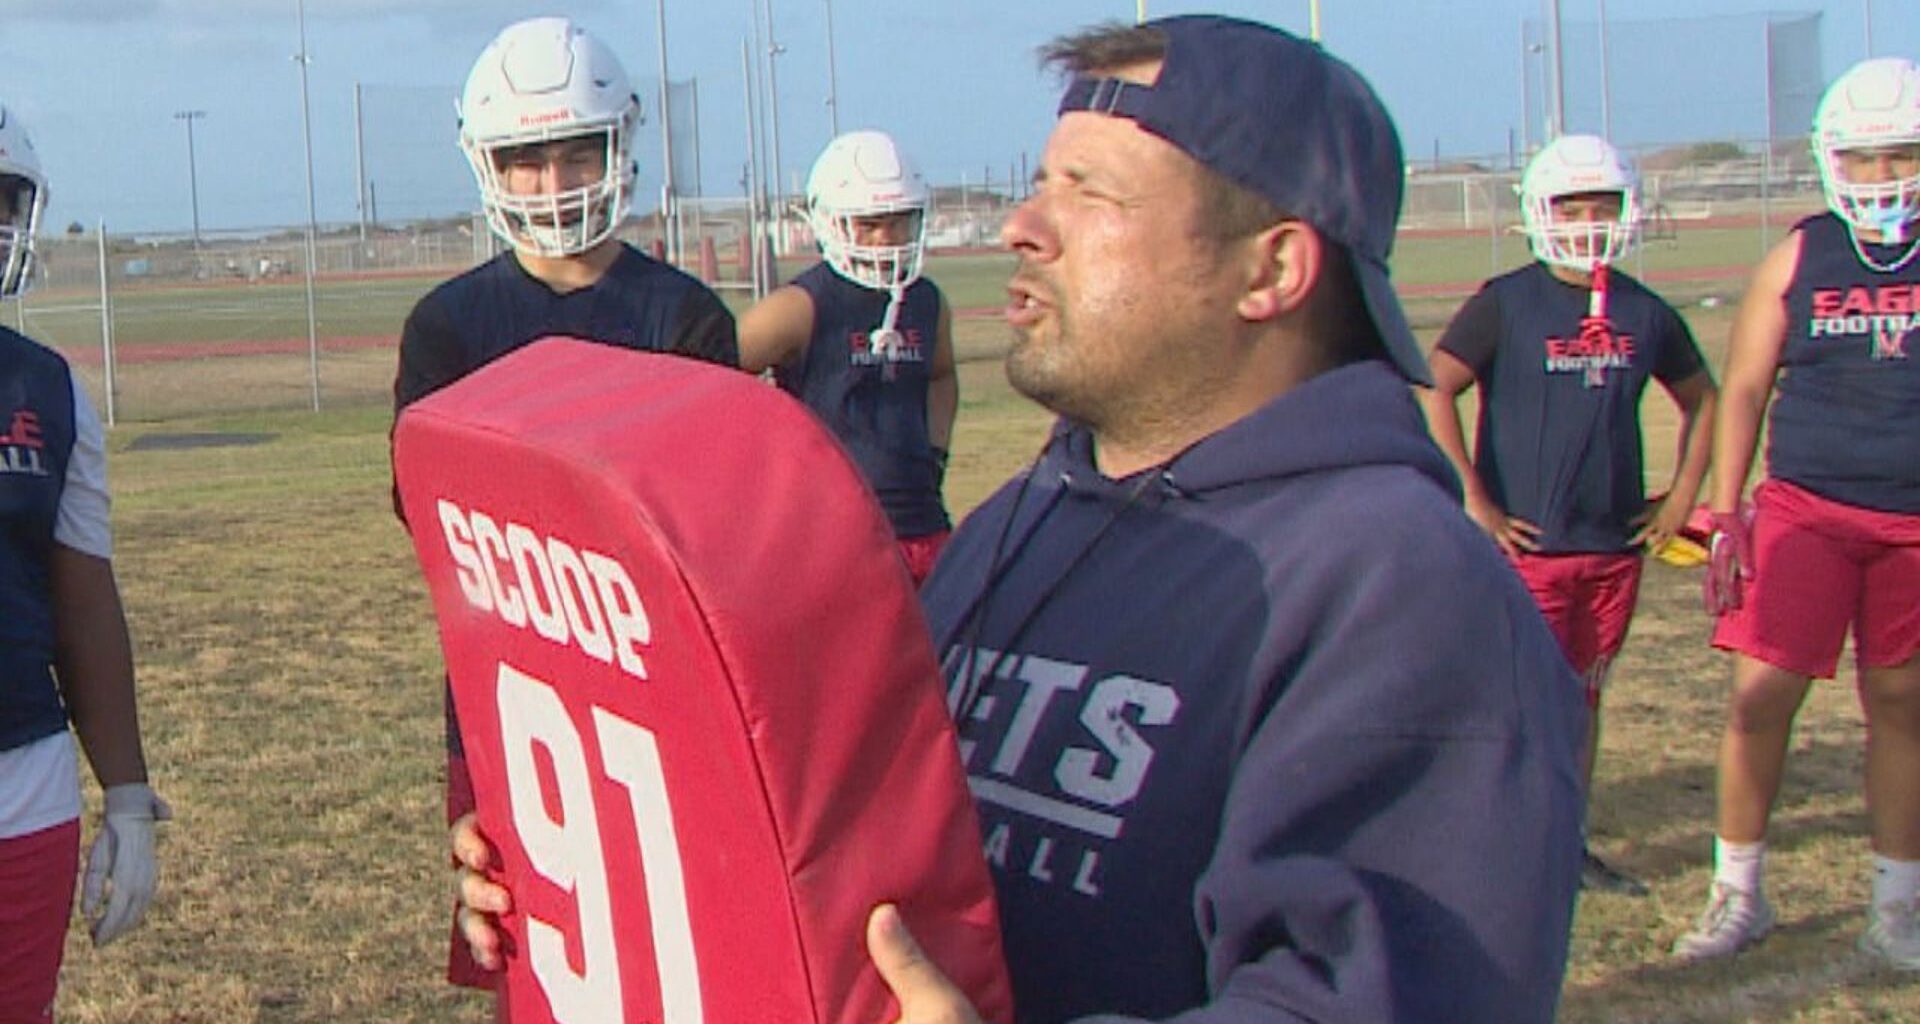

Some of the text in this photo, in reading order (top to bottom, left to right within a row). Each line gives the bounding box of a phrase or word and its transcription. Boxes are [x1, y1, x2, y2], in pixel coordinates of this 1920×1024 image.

[438, 499, 651, 680] SCOOP
[940, 644, 1181, 807] ETS
[496, 661, 702, 1024] 91
